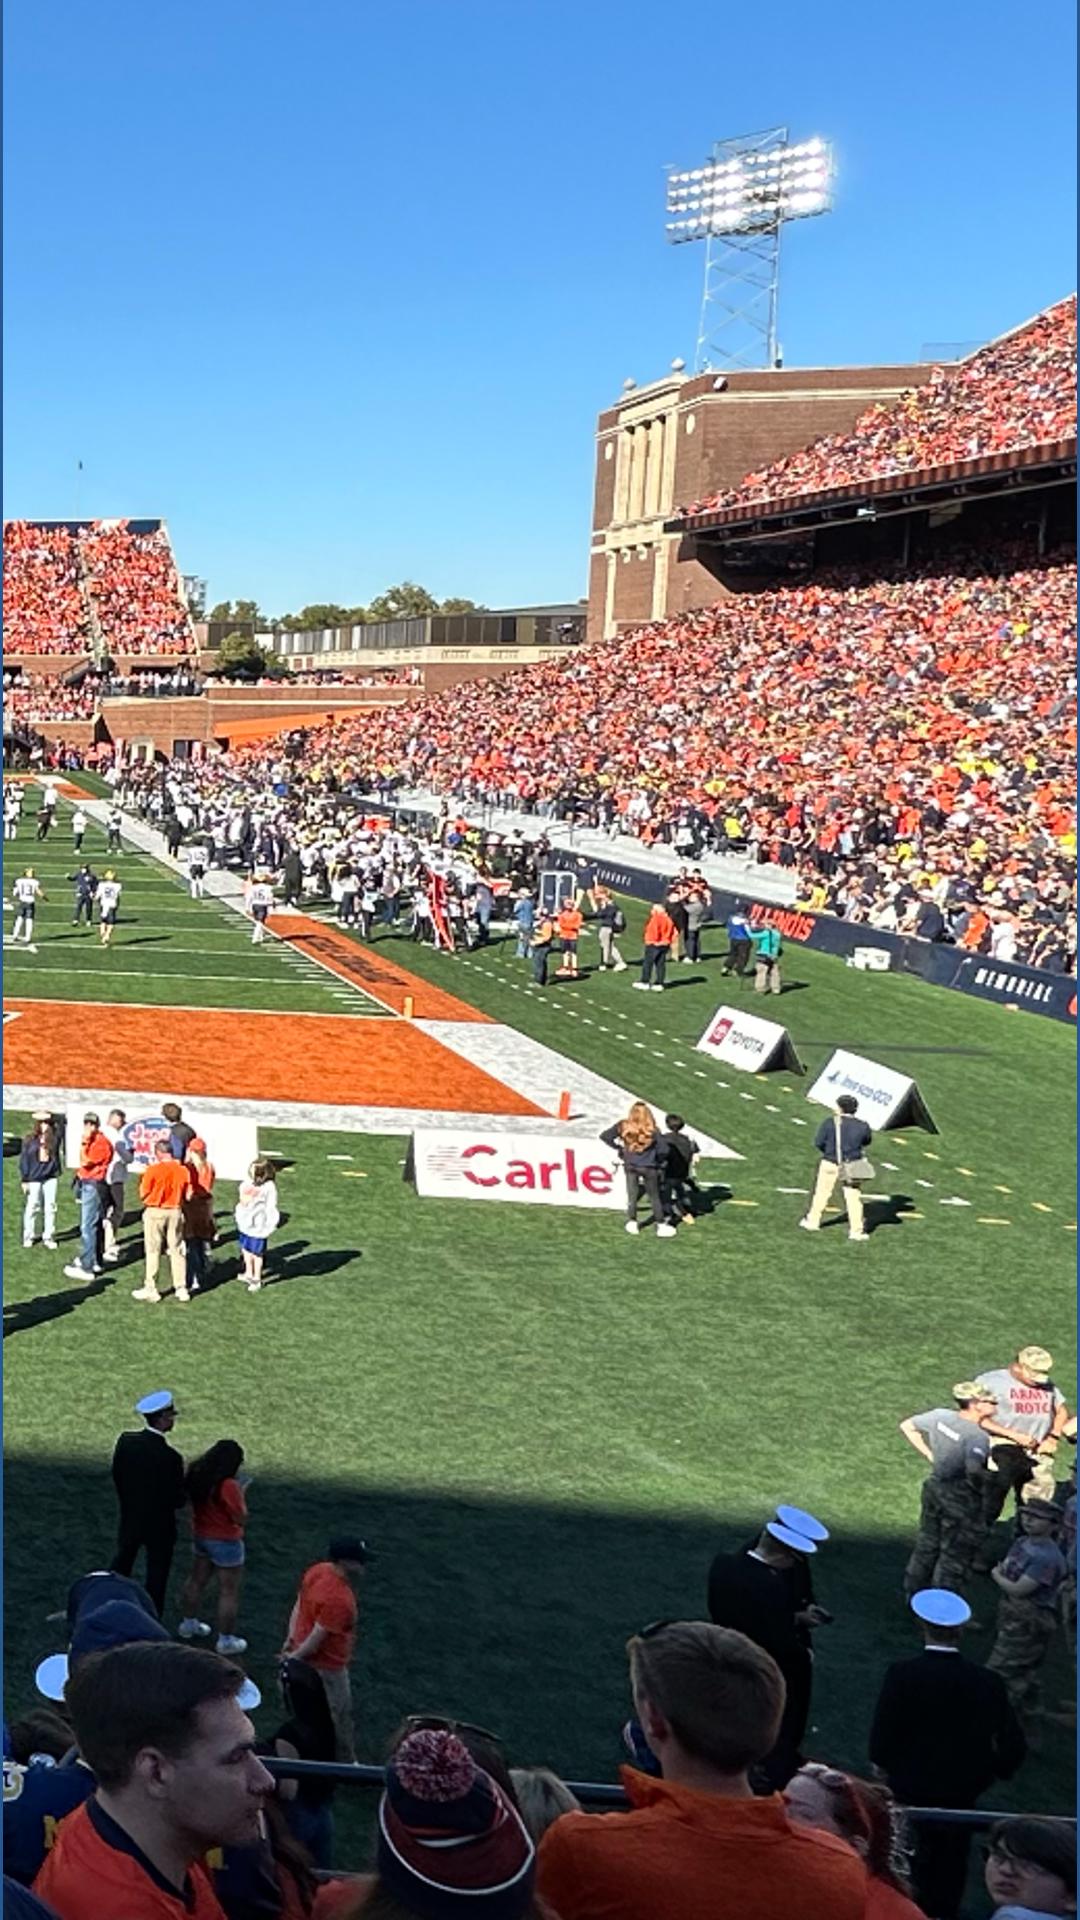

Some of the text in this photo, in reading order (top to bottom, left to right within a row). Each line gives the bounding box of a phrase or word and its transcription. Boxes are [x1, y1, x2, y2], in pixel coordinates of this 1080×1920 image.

[730, 1029, 766, 1054] TOYOTA
[460, 1143, 614, 1195] Carle
[1014, 1401, 1050, 1414] ROTC
